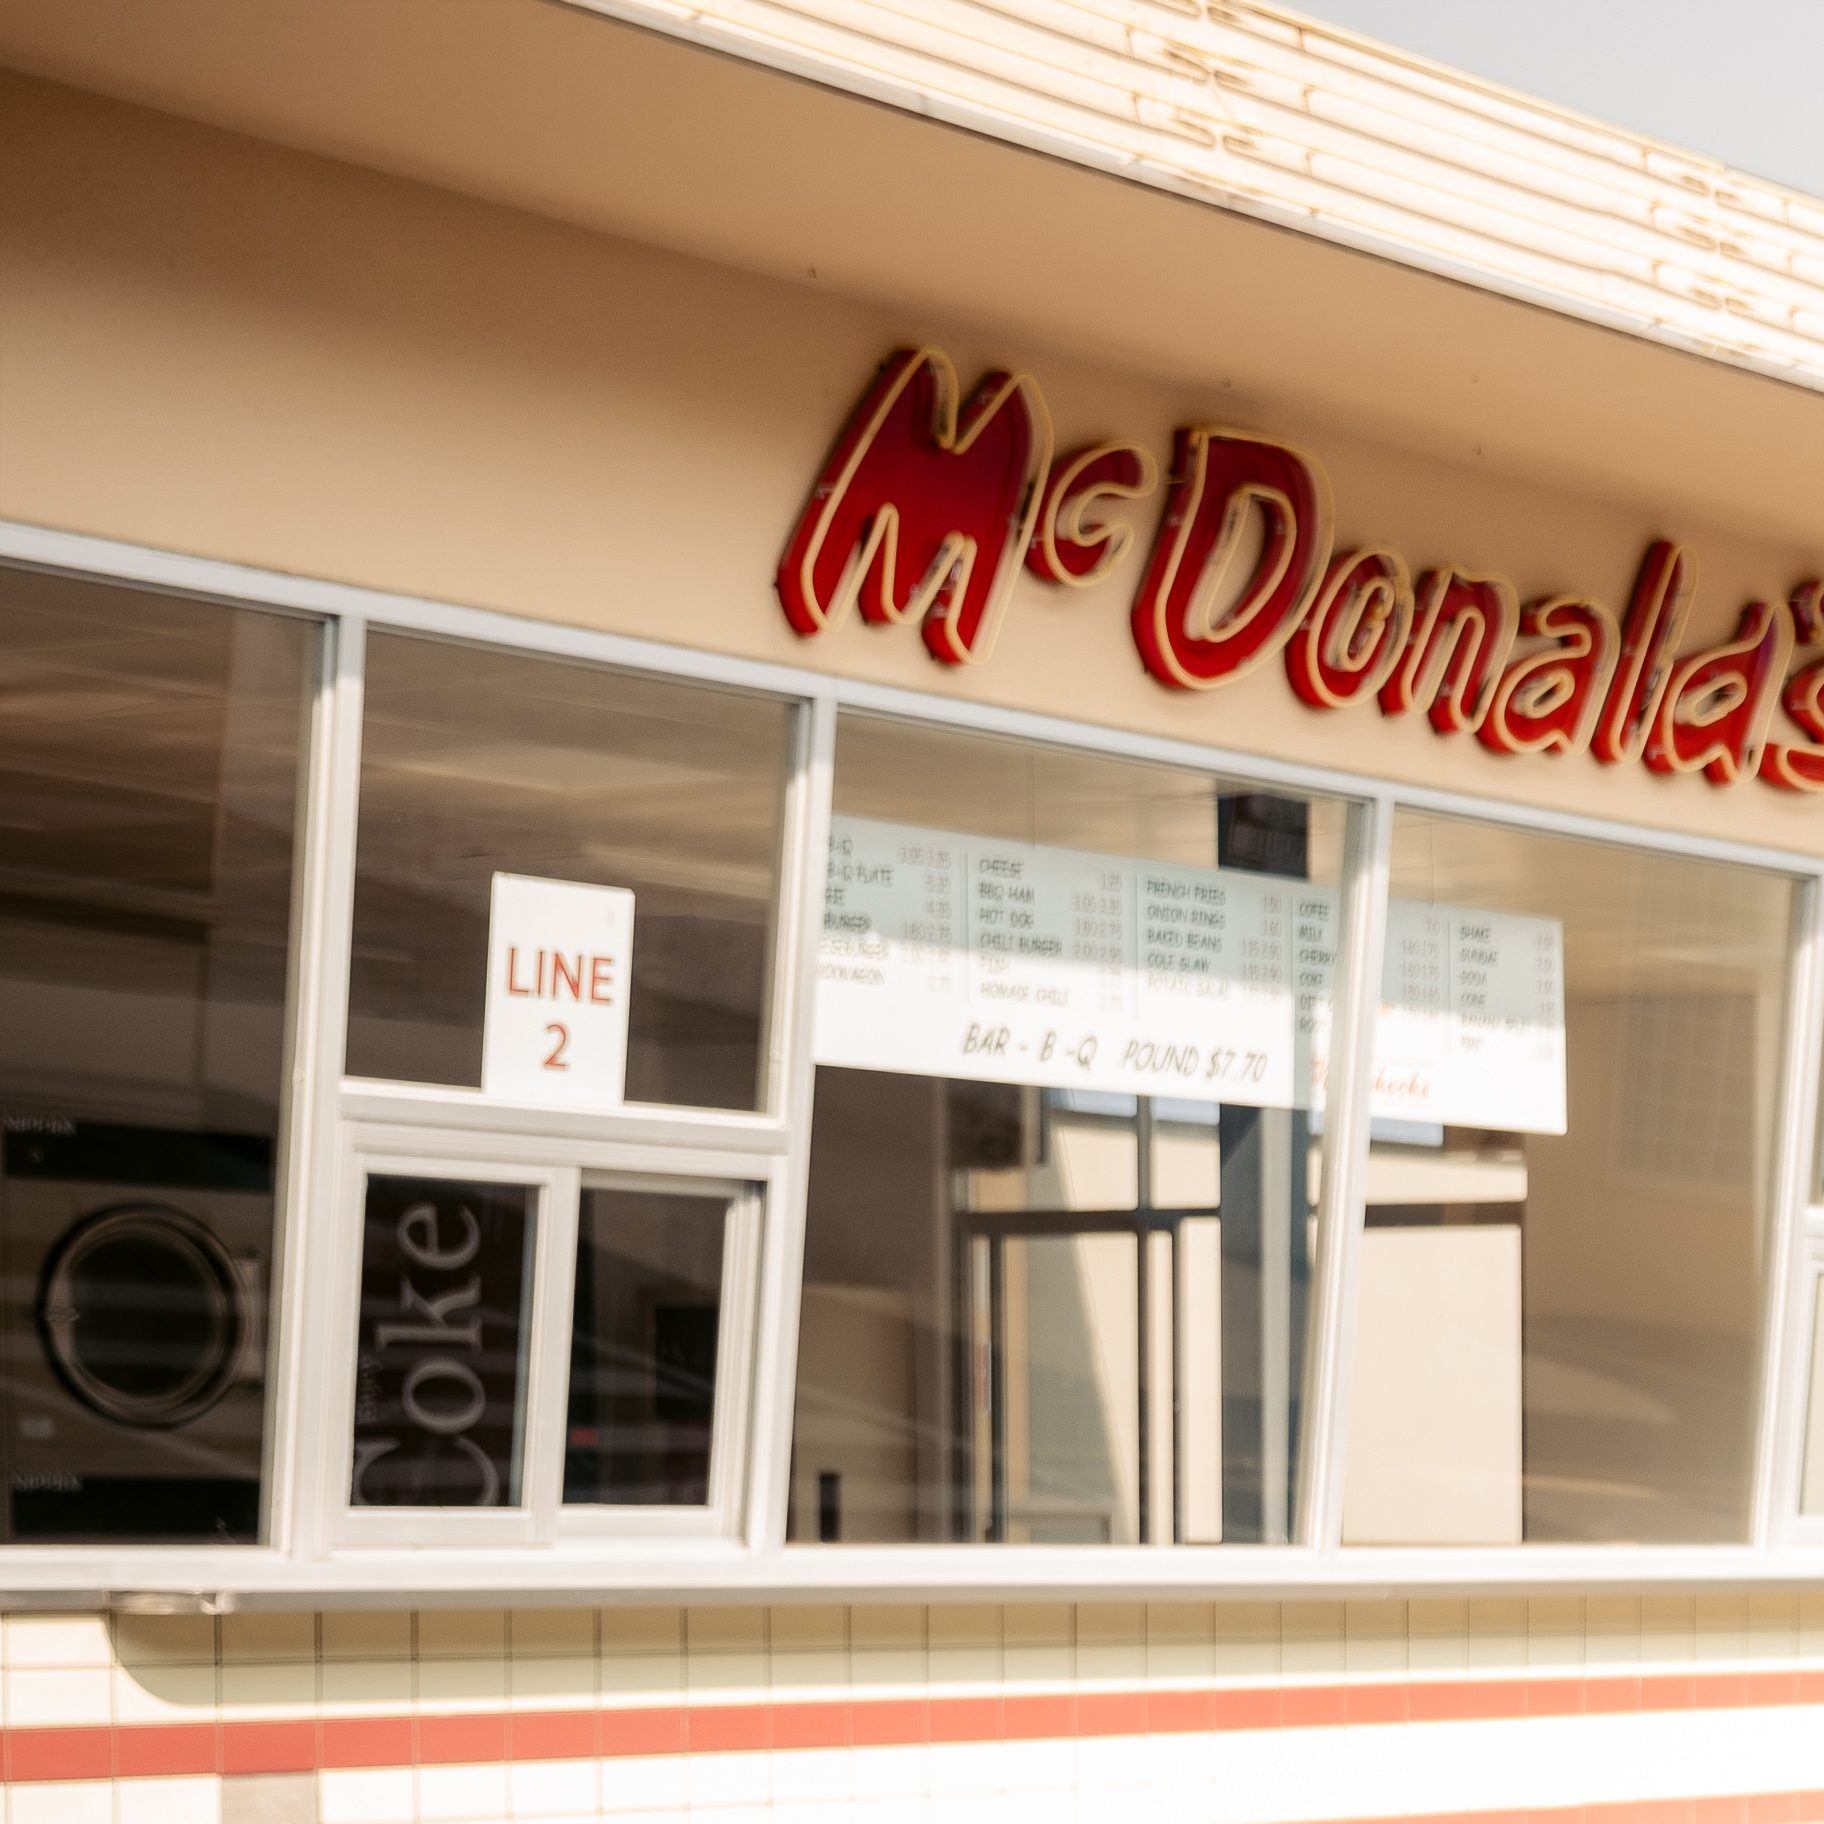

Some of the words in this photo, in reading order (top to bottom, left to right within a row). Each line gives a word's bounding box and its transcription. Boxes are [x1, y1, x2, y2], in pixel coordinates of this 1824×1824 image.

[507, 946, 614, 1005] LINE
[544, 1021, 571, 1071] 2
[1121, 1038, 1200, 1077] POUND
[1204, 1047, 1269, 1083] $7.70
[354, 1201, 501, 1506] Coke
